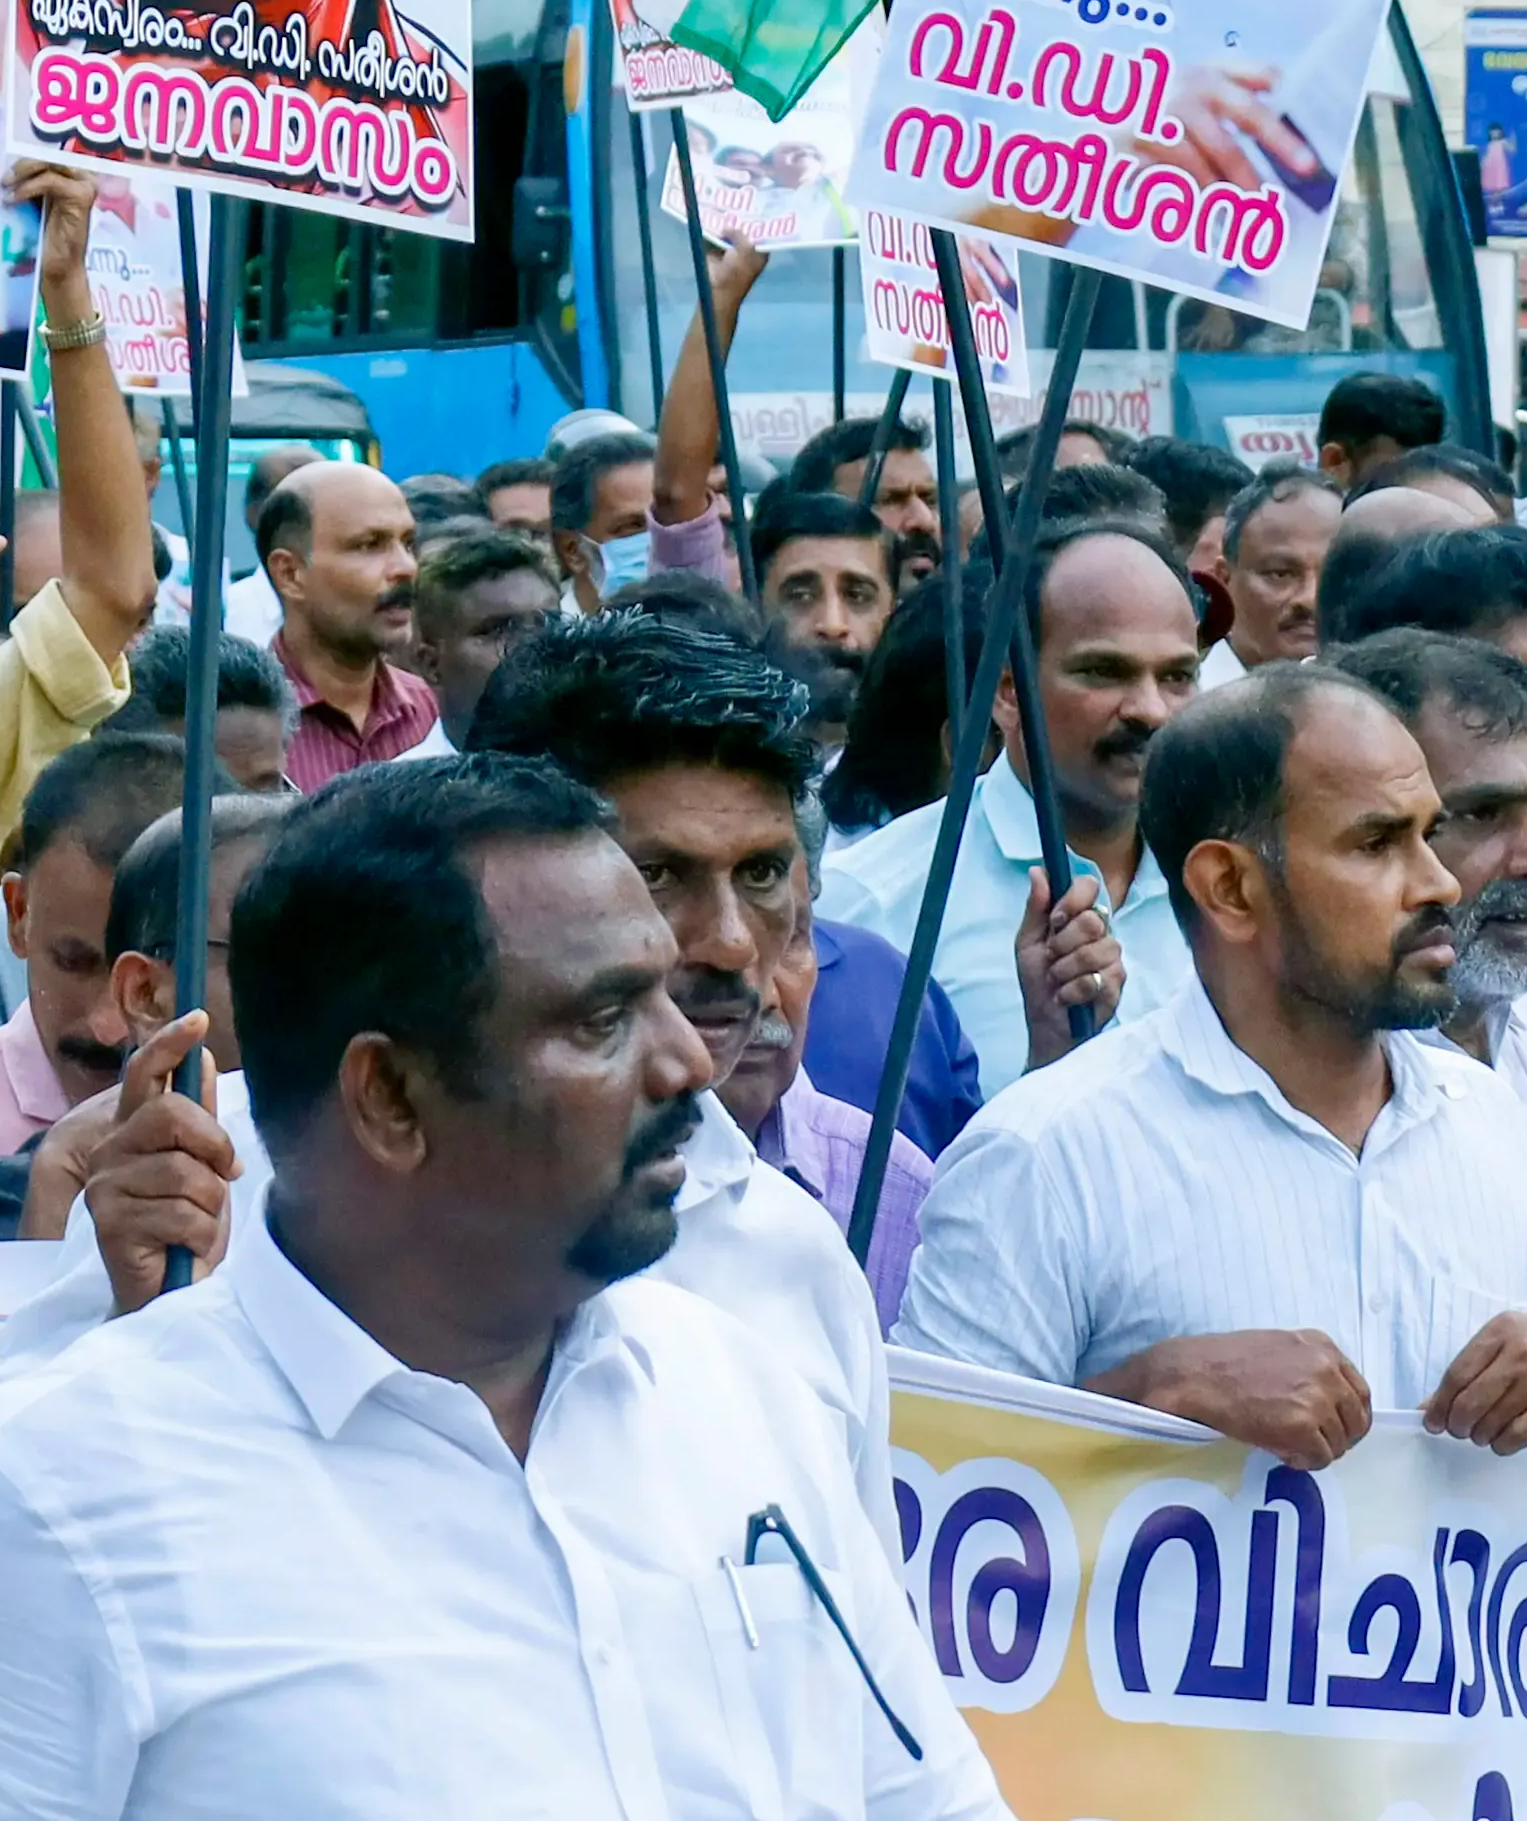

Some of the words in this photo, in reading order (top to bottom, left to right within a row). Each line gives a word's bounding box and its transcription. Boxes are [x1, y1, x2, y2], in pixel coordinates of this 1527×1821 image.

[209, 0, 312, 80] വി.ഡി.
[318, 28, 450, 103] സതീശൻ
[907, 8, 1186, 143] വി.ഡി.
[37, 53, 453, 196] ജനവാസം
[883, 104, 1286, 273] സതീശൻ
